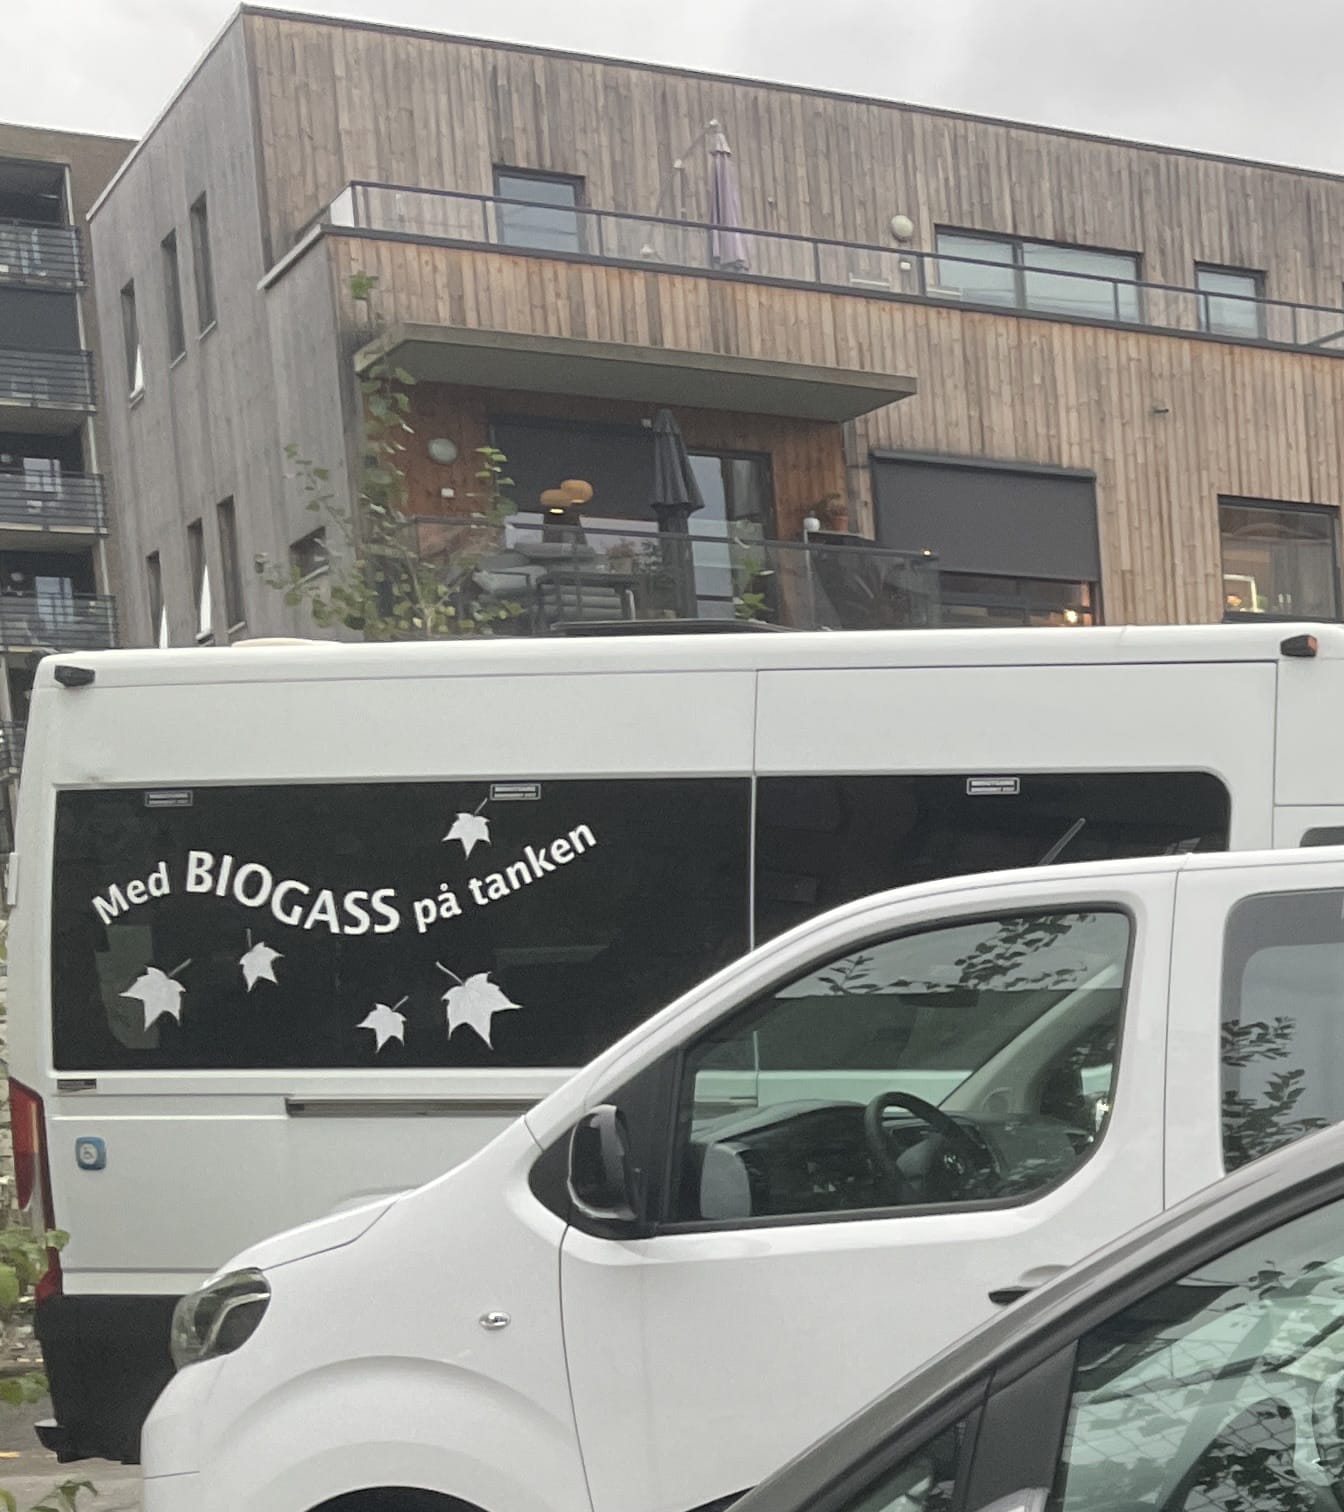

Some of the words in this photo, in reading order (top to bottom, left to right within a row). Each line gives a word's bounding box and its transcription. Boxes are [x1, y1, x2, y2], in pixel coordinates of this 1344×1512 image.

[92, 862, 170, 926] Med
[185, 850, 400, 936] BIOGASS
[413, 883, 463, 932] på
[469, 820, 598, 908] tanken
